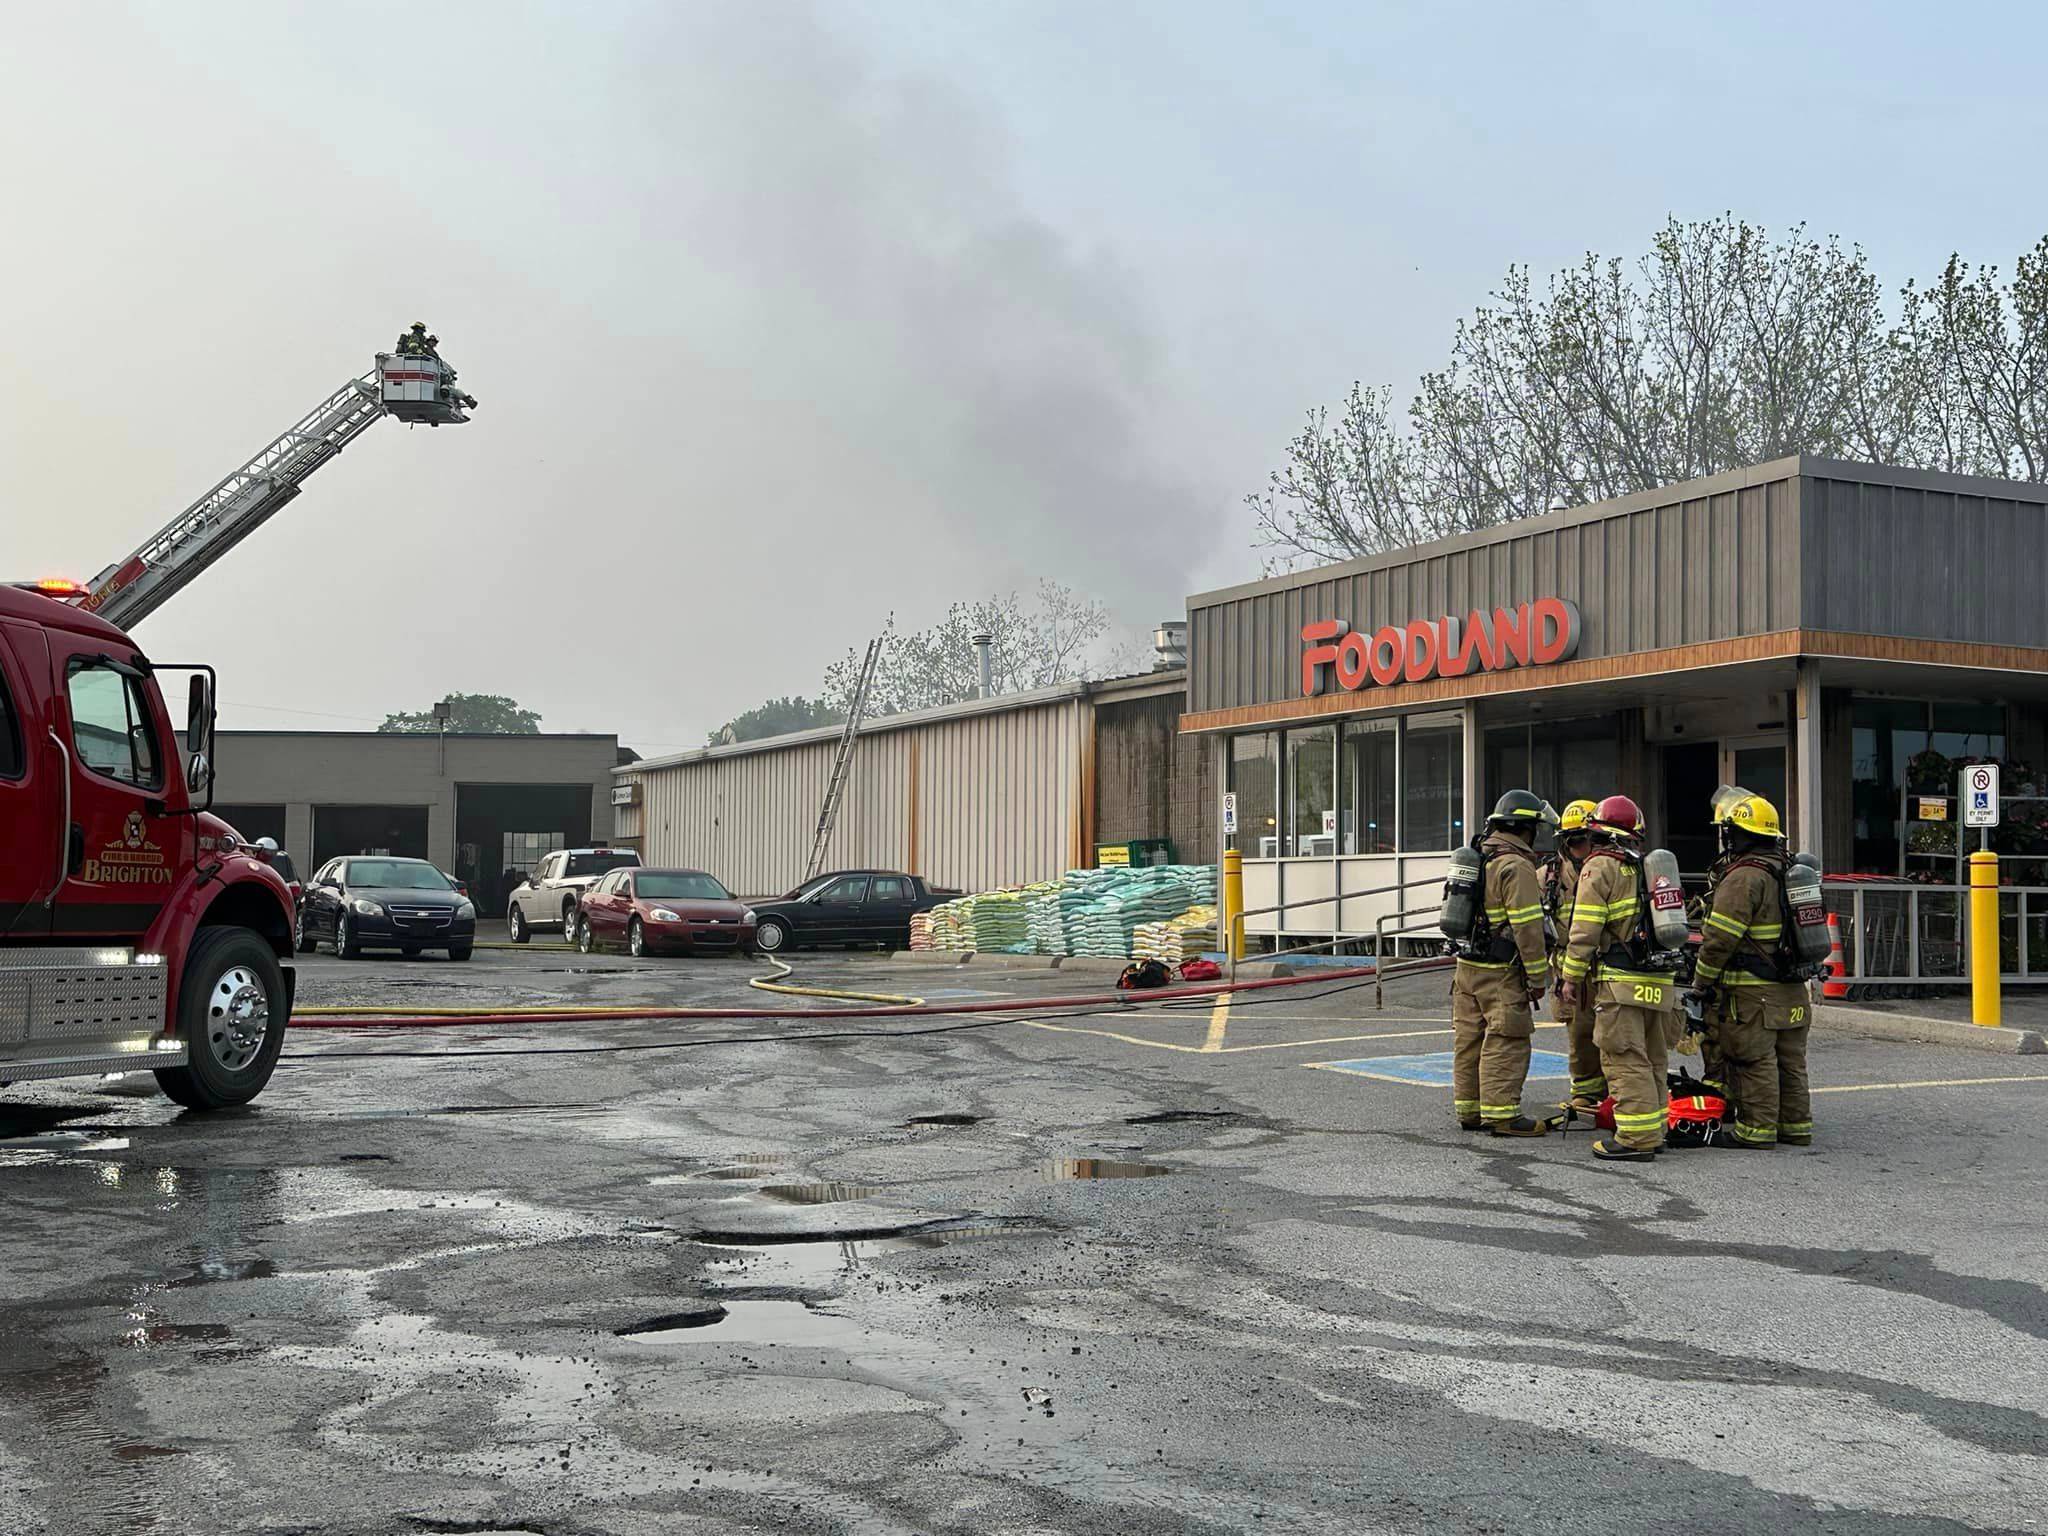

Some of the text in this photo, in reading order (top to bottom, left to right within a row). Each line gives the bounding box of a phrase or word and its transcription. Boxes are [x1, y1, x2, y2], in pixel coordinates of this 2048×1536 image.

[1302, 597, 1580, 697] FOODLAND
[84, 859, 173, 884] BRIGHTON
[1799, 907, 1823, 921] R290
[1634, 985, 1662, 1004] 209
